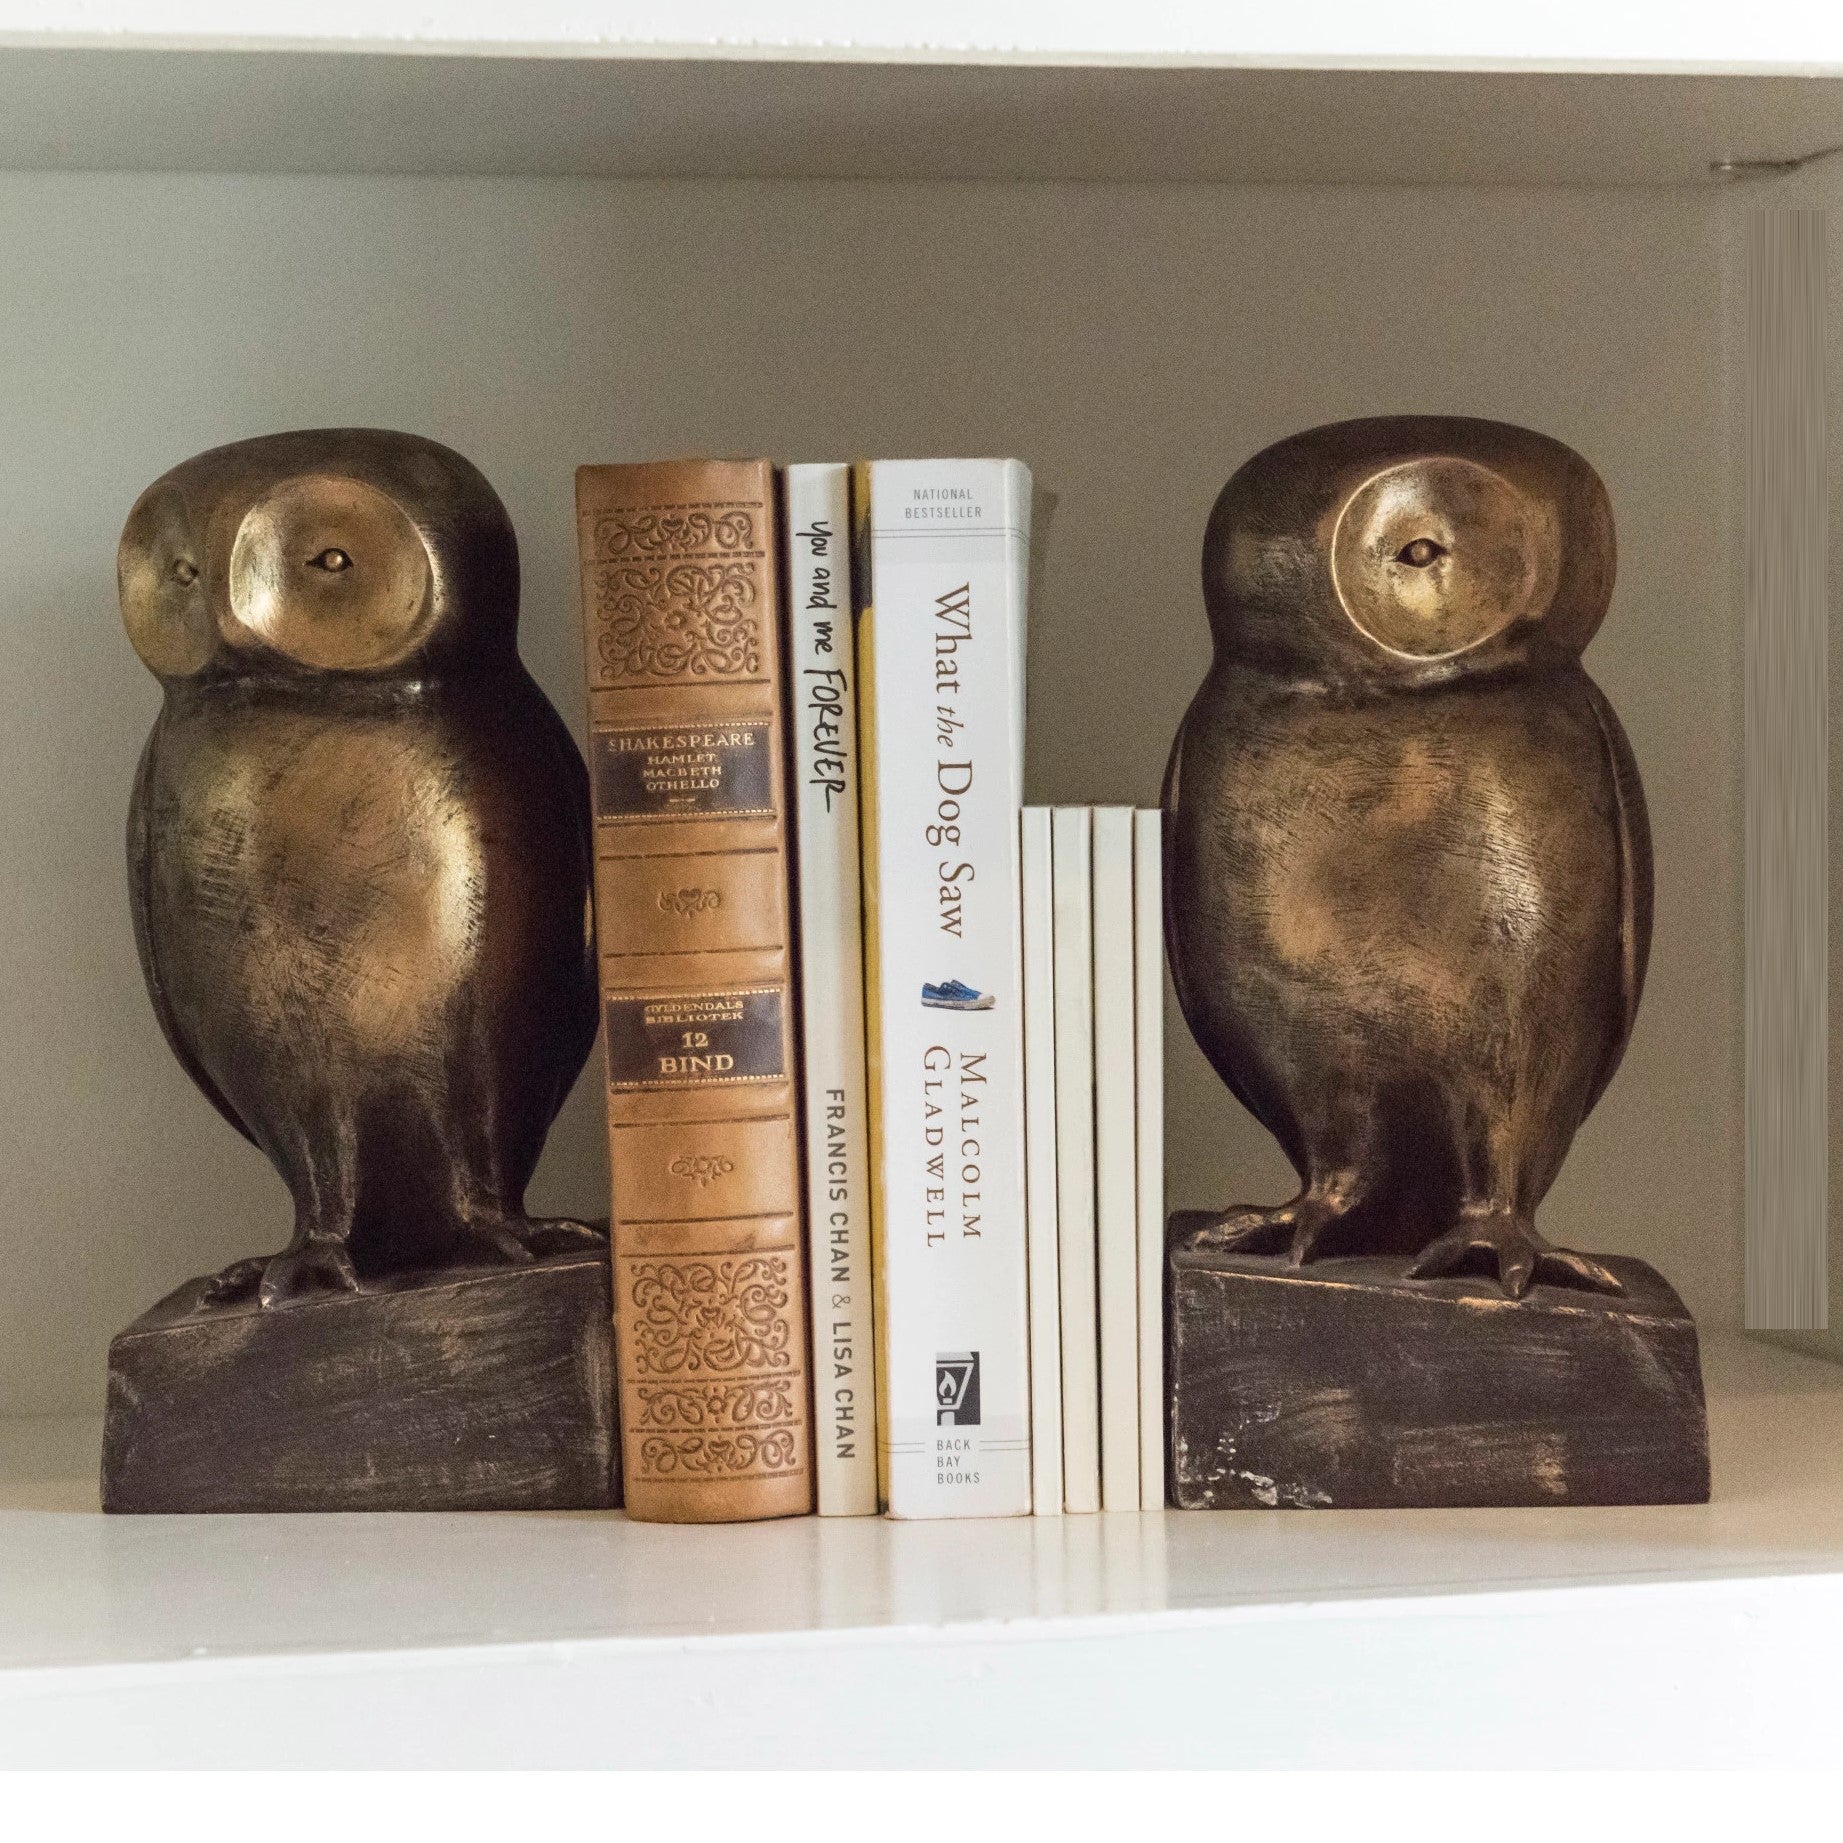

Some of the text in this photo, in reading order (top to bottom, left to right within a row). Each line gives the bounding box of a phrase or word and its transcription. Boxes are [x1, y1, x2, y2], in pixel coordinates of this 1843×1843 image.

[913, 488, 973, 500] NATIONAL
[905, 506, 982, 519] BESTSELLER
[806, 567, 837, 609] and
[813, 621, 834, 655] me
[608, 732, 754, 752] SHAKESPEARE
[803, 668, 848, 813] FOREVER
[925, 581, 975, 938] What the Dog Saw
[643, 766, 722, 778] MACBETH
[646, 779, 720, 792] OTHELLO
[644, 1001, 744, 1013] GYLDENDALS
[645, 1011, 744, 1025] BIBLIOTEK
[682, 1032, 709, 1048] 12
[659, 1054, 735, 1074] BIND
[923, 1045, 951, 1248] GLADWELL
[960, 1052, 987, 1239] MALCOLM
[825, 1089, 856, 1459] FRANCIS CHAN & LISA CHAN
[936, 1439, 971, 1451] BACK
[937, 1456, 961, 1468] BAY
[937, 1472, 981, 1485] BOOKS
